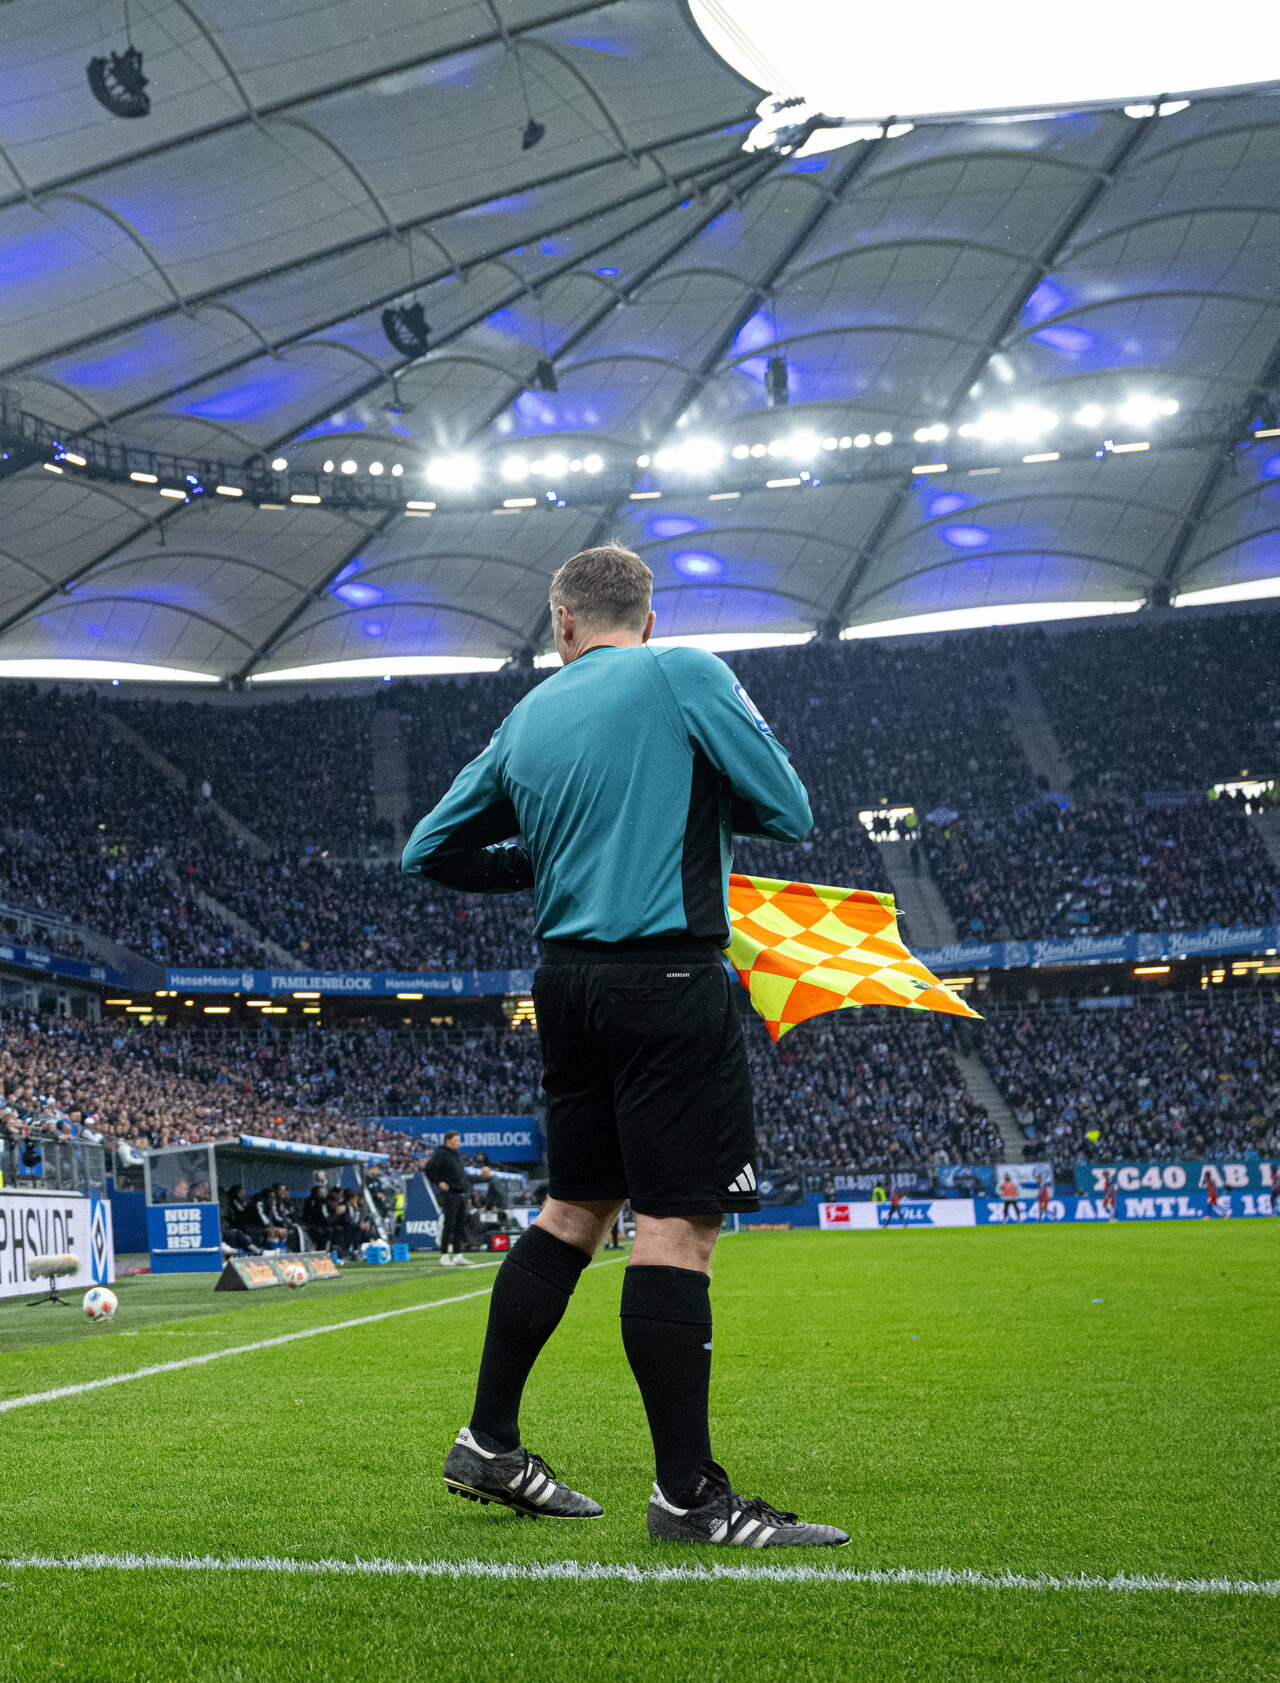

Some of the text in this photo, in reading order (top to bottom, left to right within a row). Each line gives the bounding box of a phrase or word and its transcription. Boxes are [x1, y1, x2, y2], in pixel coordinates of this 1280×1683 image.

[170, 975, 240, 986] HanseMerkur
[271, 976, 372, 990] FAMILIENBLOCK
[385, 979, 450, 989] HanseMerkur
[1091, 1166, 1187, 1191] XC40
[1198, 1164, 1250, 1189] AB
[1125, 1196, 1204, 1219] MTL.
[164, 1208, 202, 1222] NUR
[166, 1222, 201, 1235] DER
[405, 1220, 439, 1236] VISA
[167, 1235, 202, 1249] HSV
